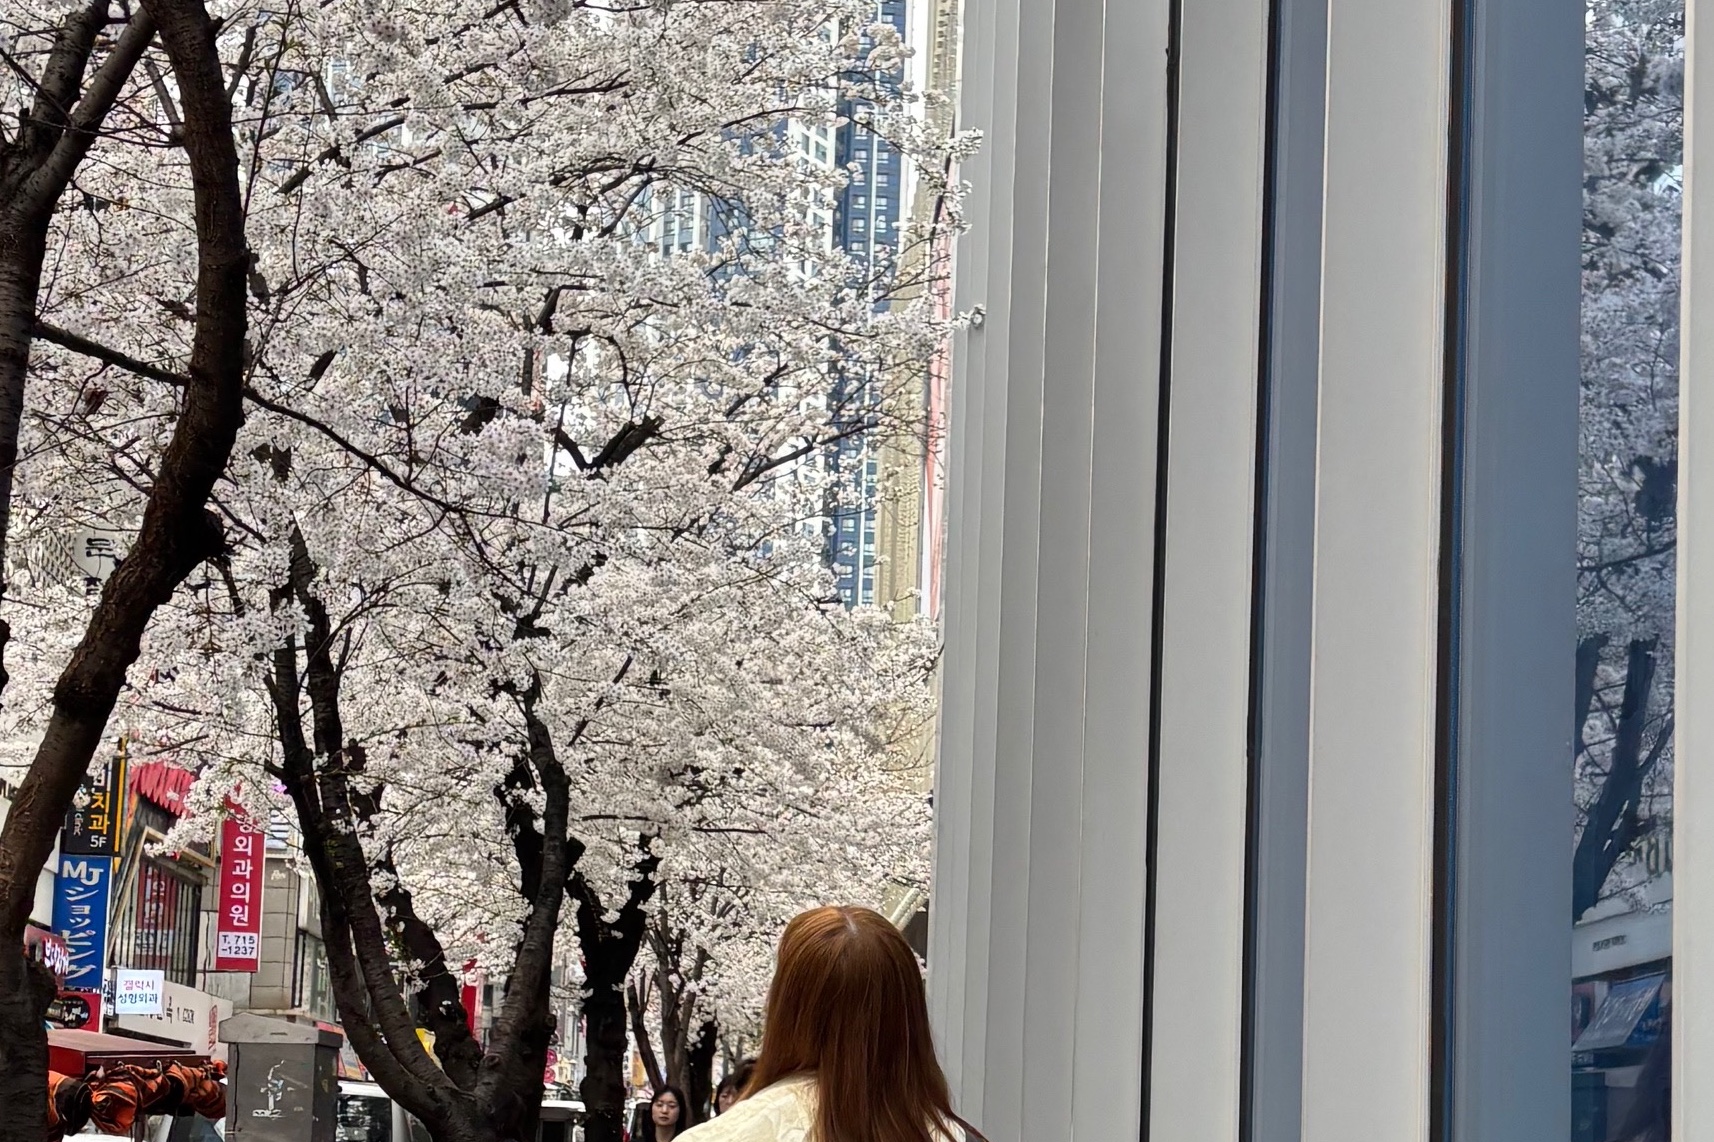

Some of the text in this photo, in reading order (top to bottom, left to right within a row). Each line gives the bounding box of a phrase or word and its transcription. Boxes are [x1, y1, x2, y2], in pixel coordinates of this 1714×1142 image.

[90, 835, 107, 848] 5F
[62, 860, 104, 886] MJ
[234, 934, 255, 945] 715
[221, 945, 255, 956] -1237
[117, 993, 158, 1004] 성형외과
